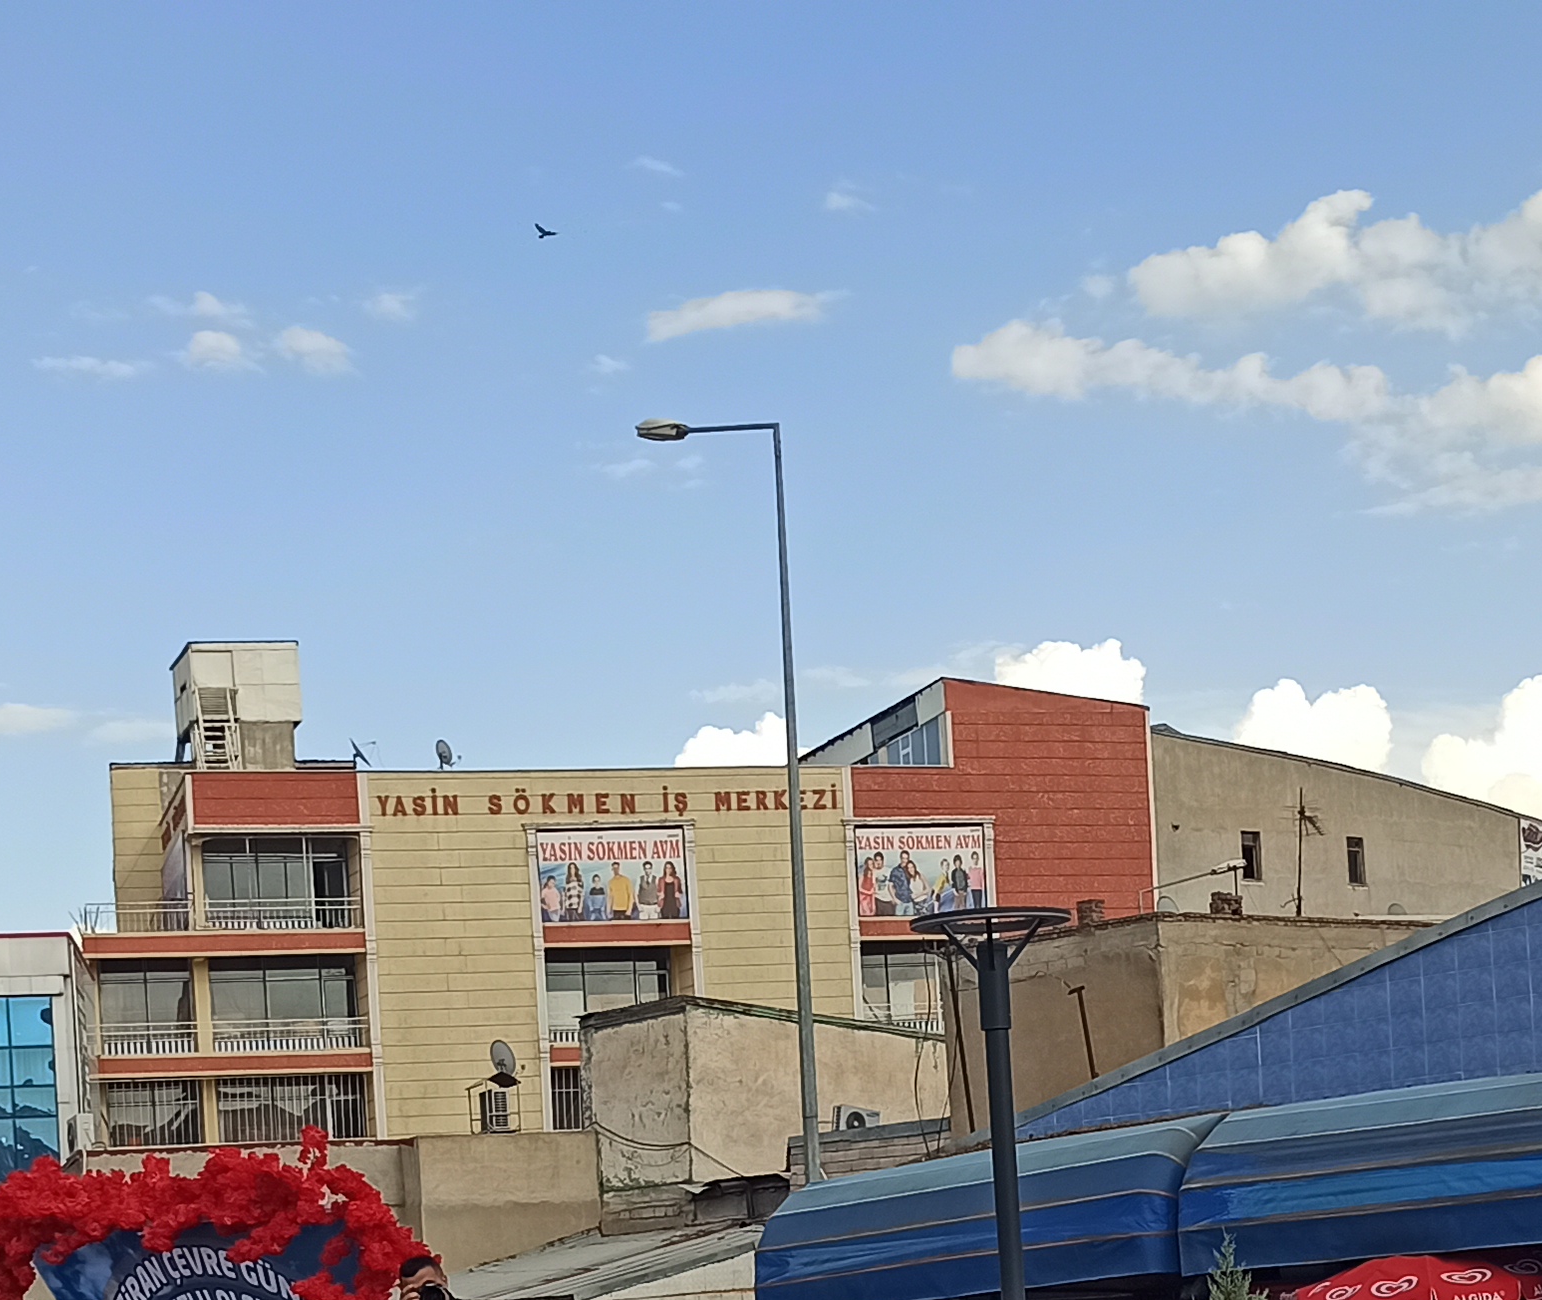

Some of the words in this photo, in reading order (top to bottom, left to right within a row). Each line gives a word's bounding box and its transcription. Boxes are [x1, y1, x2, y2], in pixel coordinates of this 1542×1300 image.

[377, 787, 459, 817] YASİN
[488, 788, 638, 815] SÖKMEN
[662, 786, 689, 818] İŞ
[714, 783, 838, 812] MERKEZİ
[651, 839, 681, 859] AVM
[956, 835, 981, 849] AVM
[162, 1247, 237, 1286] ÇEVRE
